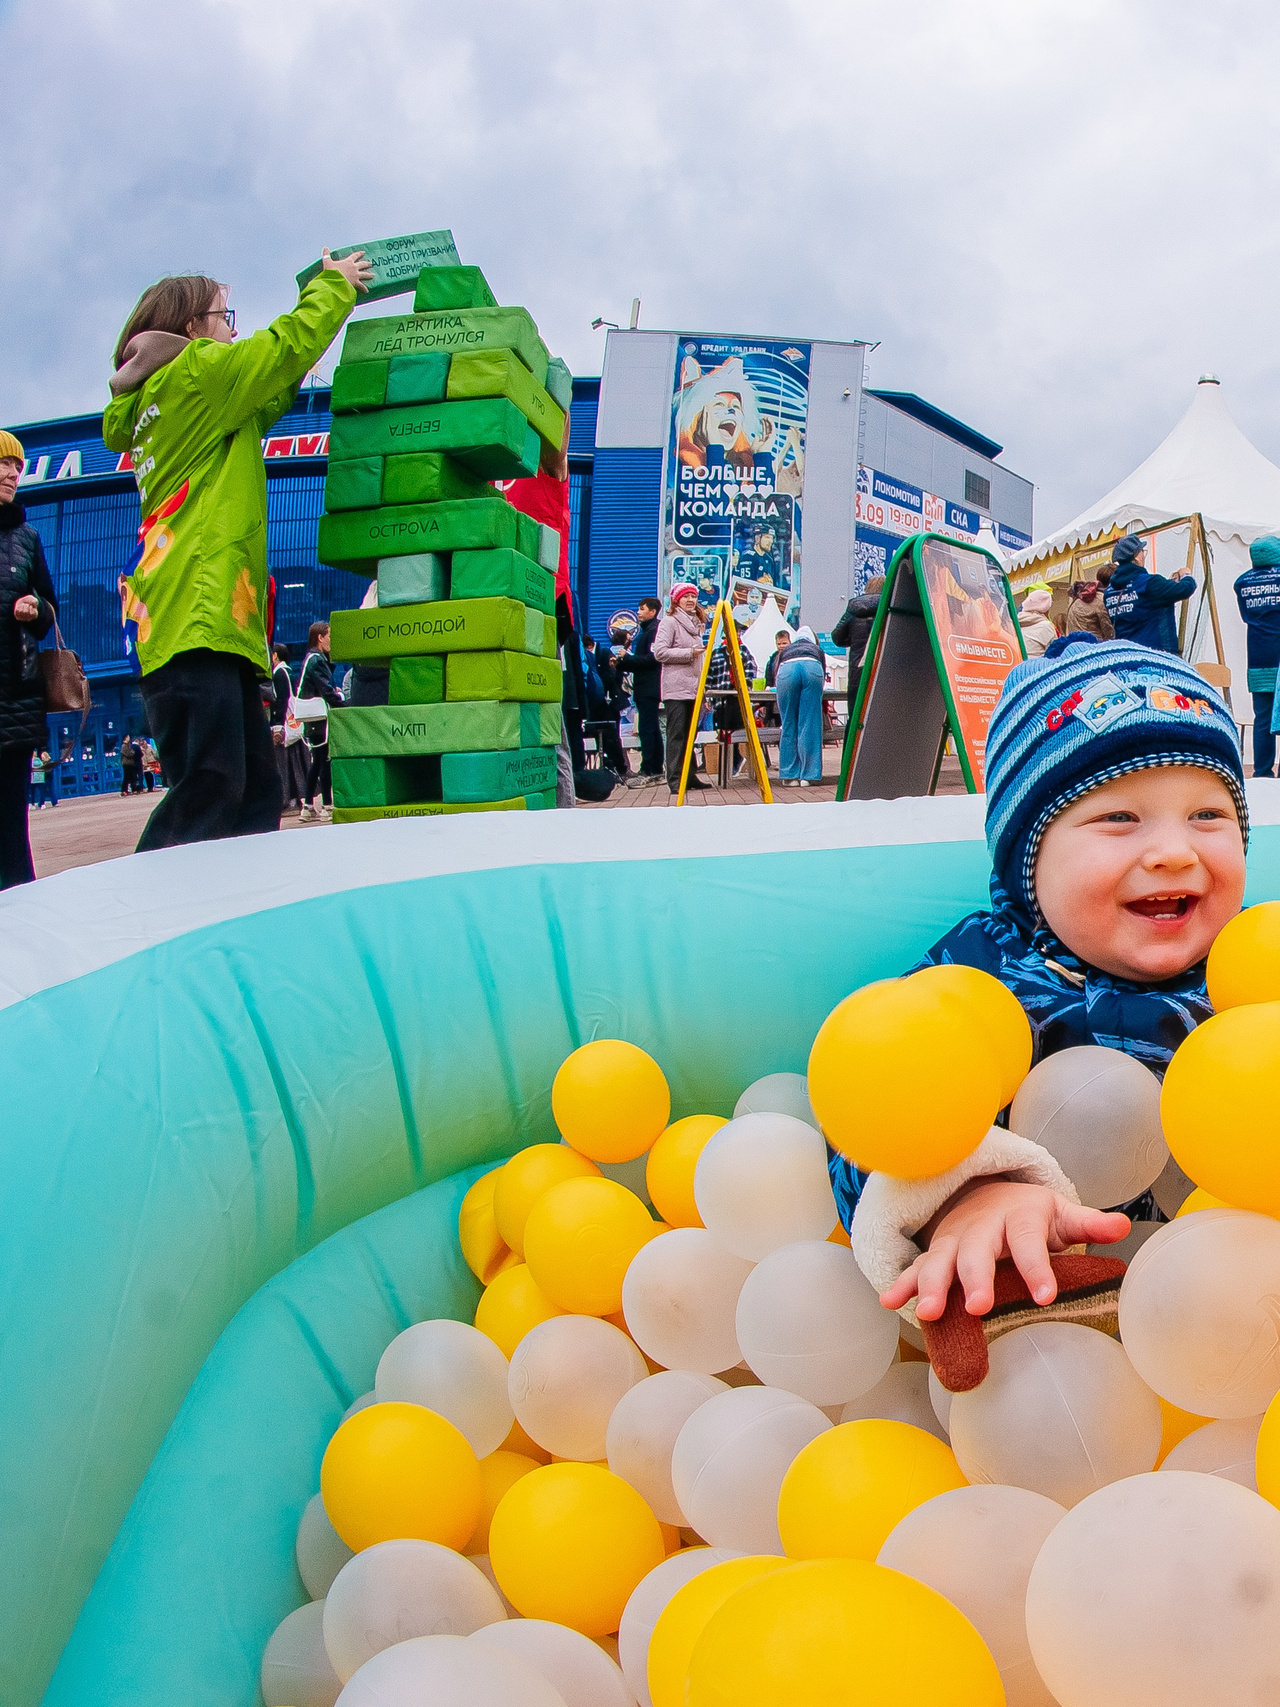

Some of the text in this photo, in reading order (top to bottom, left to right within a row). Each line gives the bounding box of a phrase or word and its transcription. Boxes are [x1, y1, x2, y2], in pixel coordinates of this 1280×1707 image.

[386, 239, 415, 252] ФОРУМ
[367, 252, 410, 268] АЛЬНОГО
[373, 330, 485, 352] ЛЁД ТРОНУЛСЯ
[701, 343, 729, 353] КРЕДИТ
[531, 392, 546, 416] УТРО
[388, 420, 441, 437] БЕРЕГА
[681, 464, 772, 485] БОЛЬШЕ,
[680, 483, 721, 499] ЧЕМ
[874, 479, 921, 508] ЛОКОМОТИВ
[679, 501, 780, 520] КОМАНДА
[889, 506, 920, 530] 19:00
[950, 508, 969, 529] СКА
[740, 567, 751, 578] 85
[361, 615, 466, 641] ЮГ МОЛОДОЙ
[955, 642, 1008, 660] #МЫВМЕСТЕ
[959, 694, 997, 705] #МЫВМЕСТЕ
[391, 722, 427, 737] ШУМ
